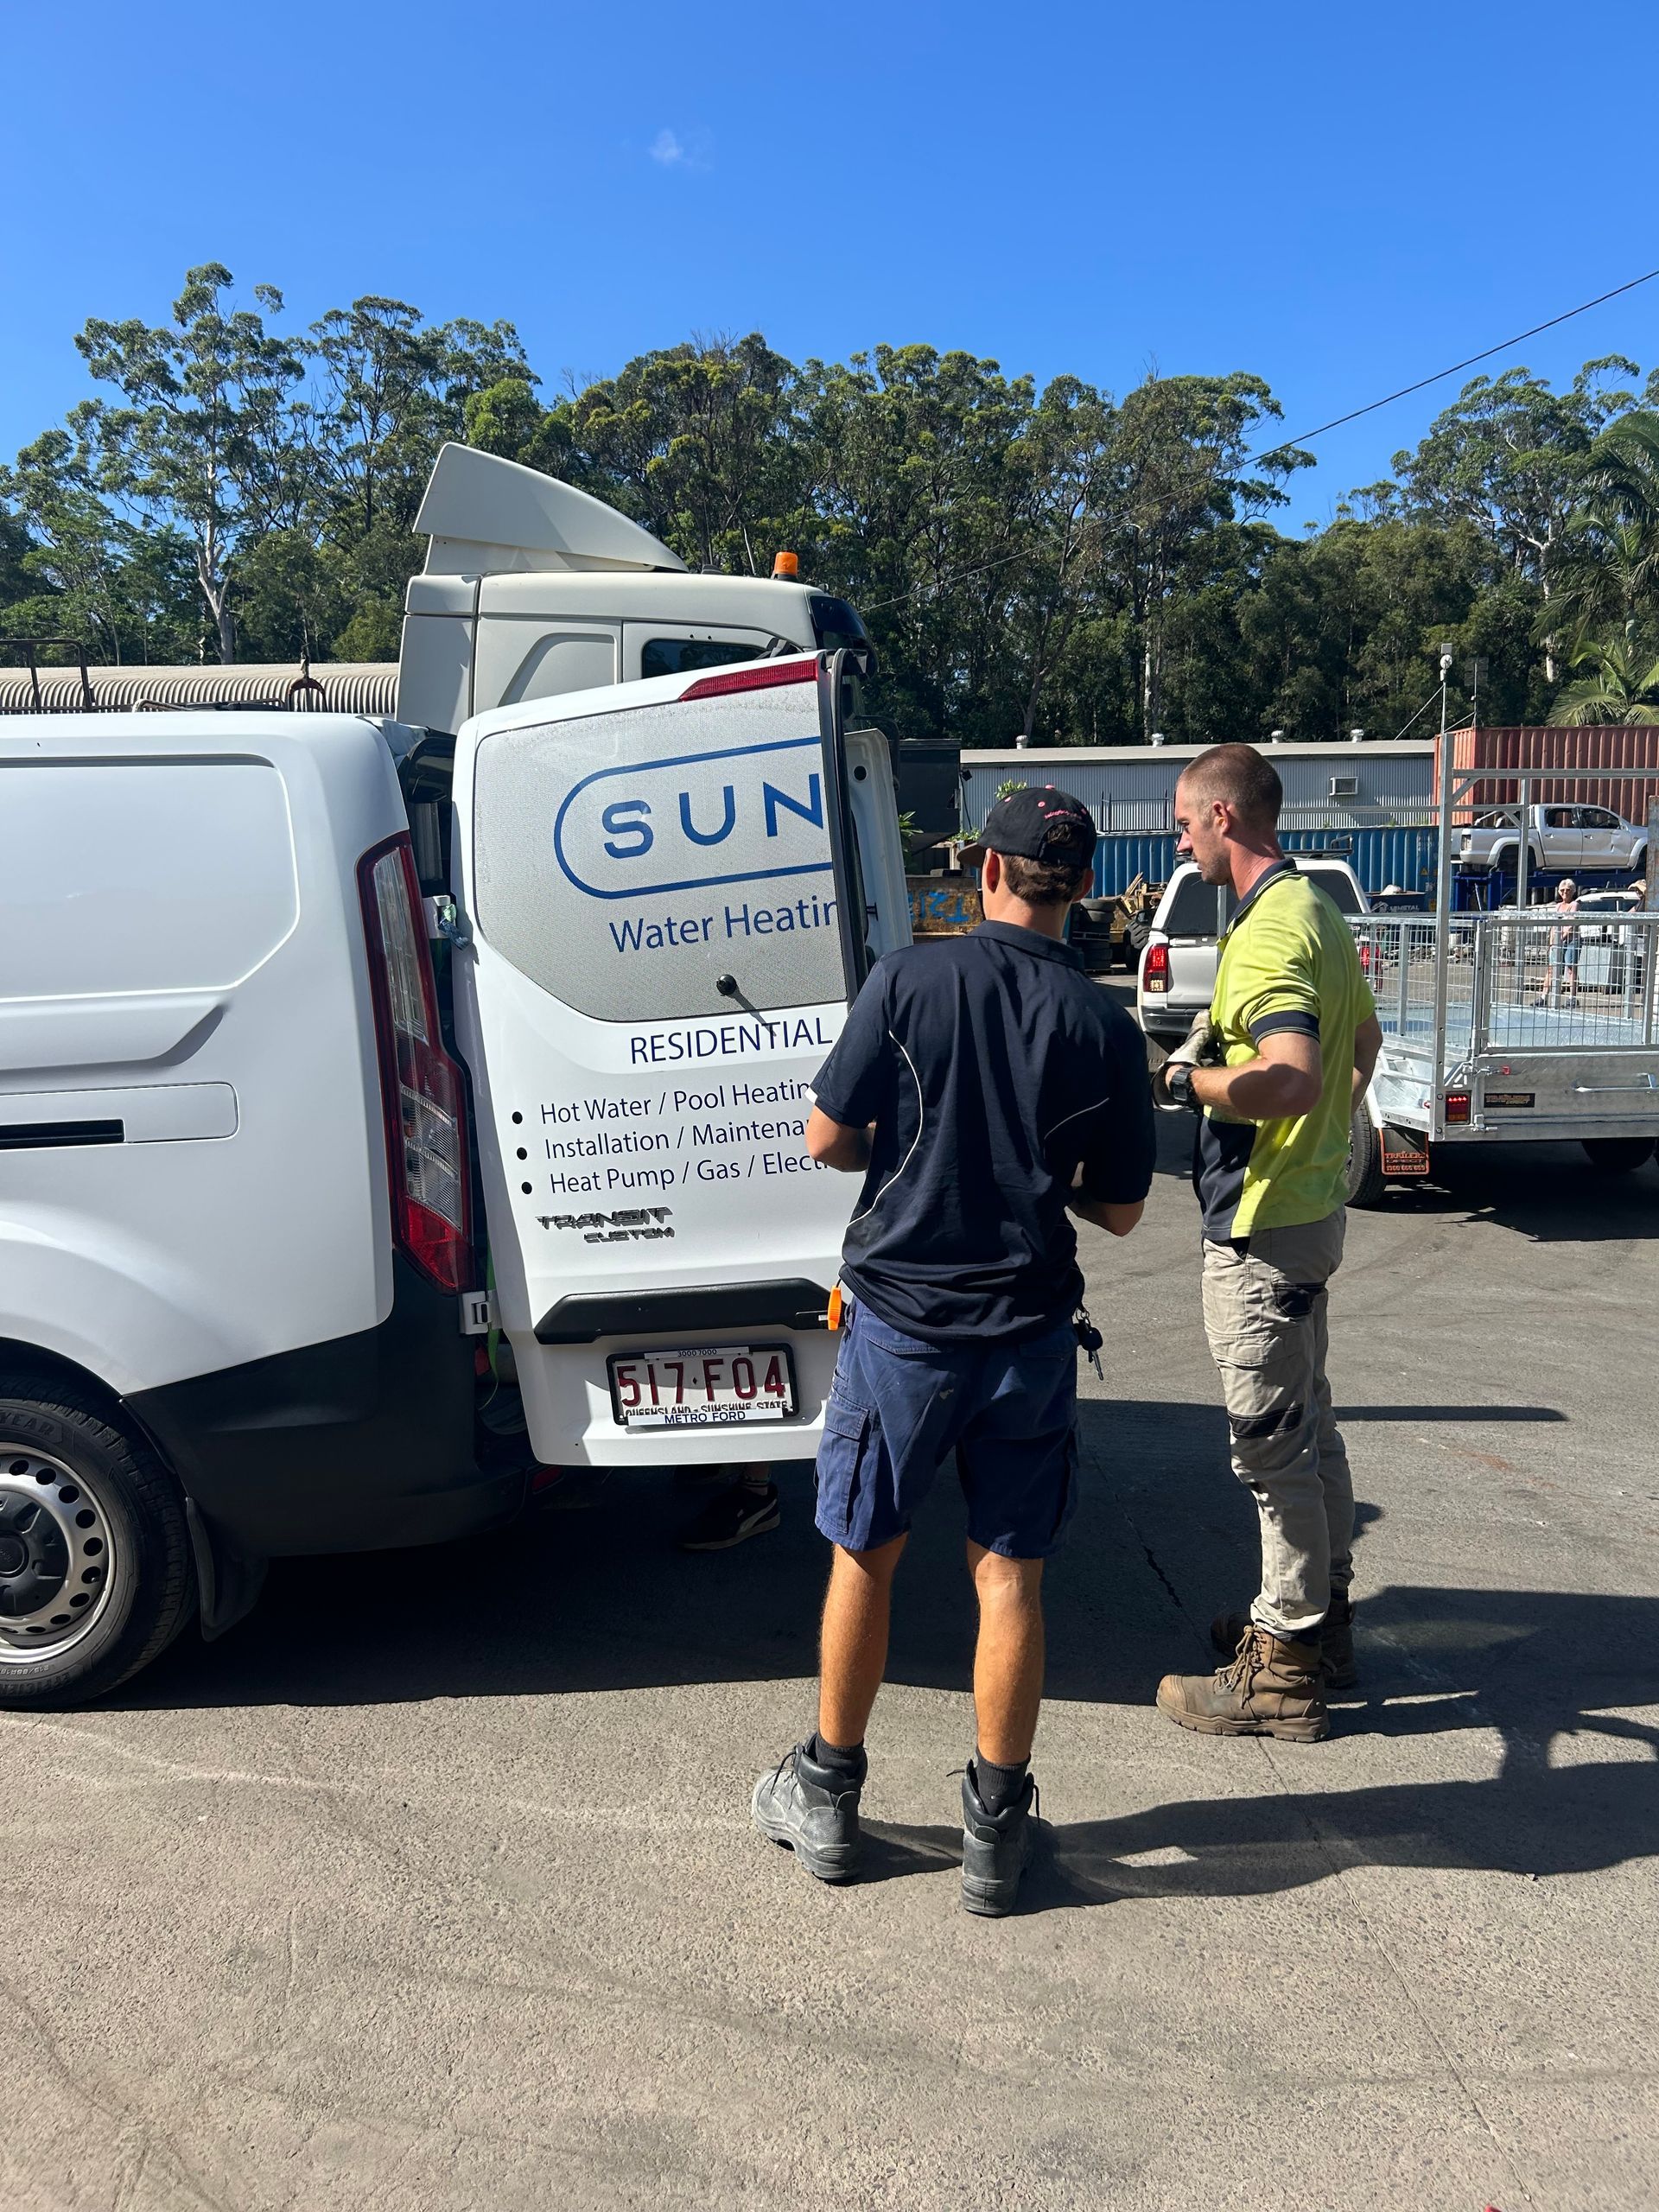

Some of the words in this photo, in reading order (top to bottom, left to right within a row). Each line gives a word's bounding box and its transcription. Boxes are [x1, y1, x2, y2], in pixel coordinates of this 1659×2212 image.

[601, 773, 824, 859] SUN
[609, 916, 713, 953] Water
[631, 1018, 833, 1065] RESIDENTIAL
[540, 1102, 579, 1124] Hot
[583, 1096, 652, 1121] Water
[674, 1085, 725, 1112] Pool
[545, 1133, 670, 1160] Installation
[692, 1118, 809, 1147] Maintena
[550, 1170, 601, 1194] Heat
[607, 1166, 675, 1190] Pump
[697, 1159, 741, 1182] Gas
[535, 1206, 673, 1230] TRANSIT
[583, 1227, 676, 1243] CUSTOM
[664, 1413, 707, 1424] METRO
[712, 1410, 746, 1421] FORD
[701, 1402, 752, 1413] SUNSHINE
[756, 1400, 788, 1410] STATE
